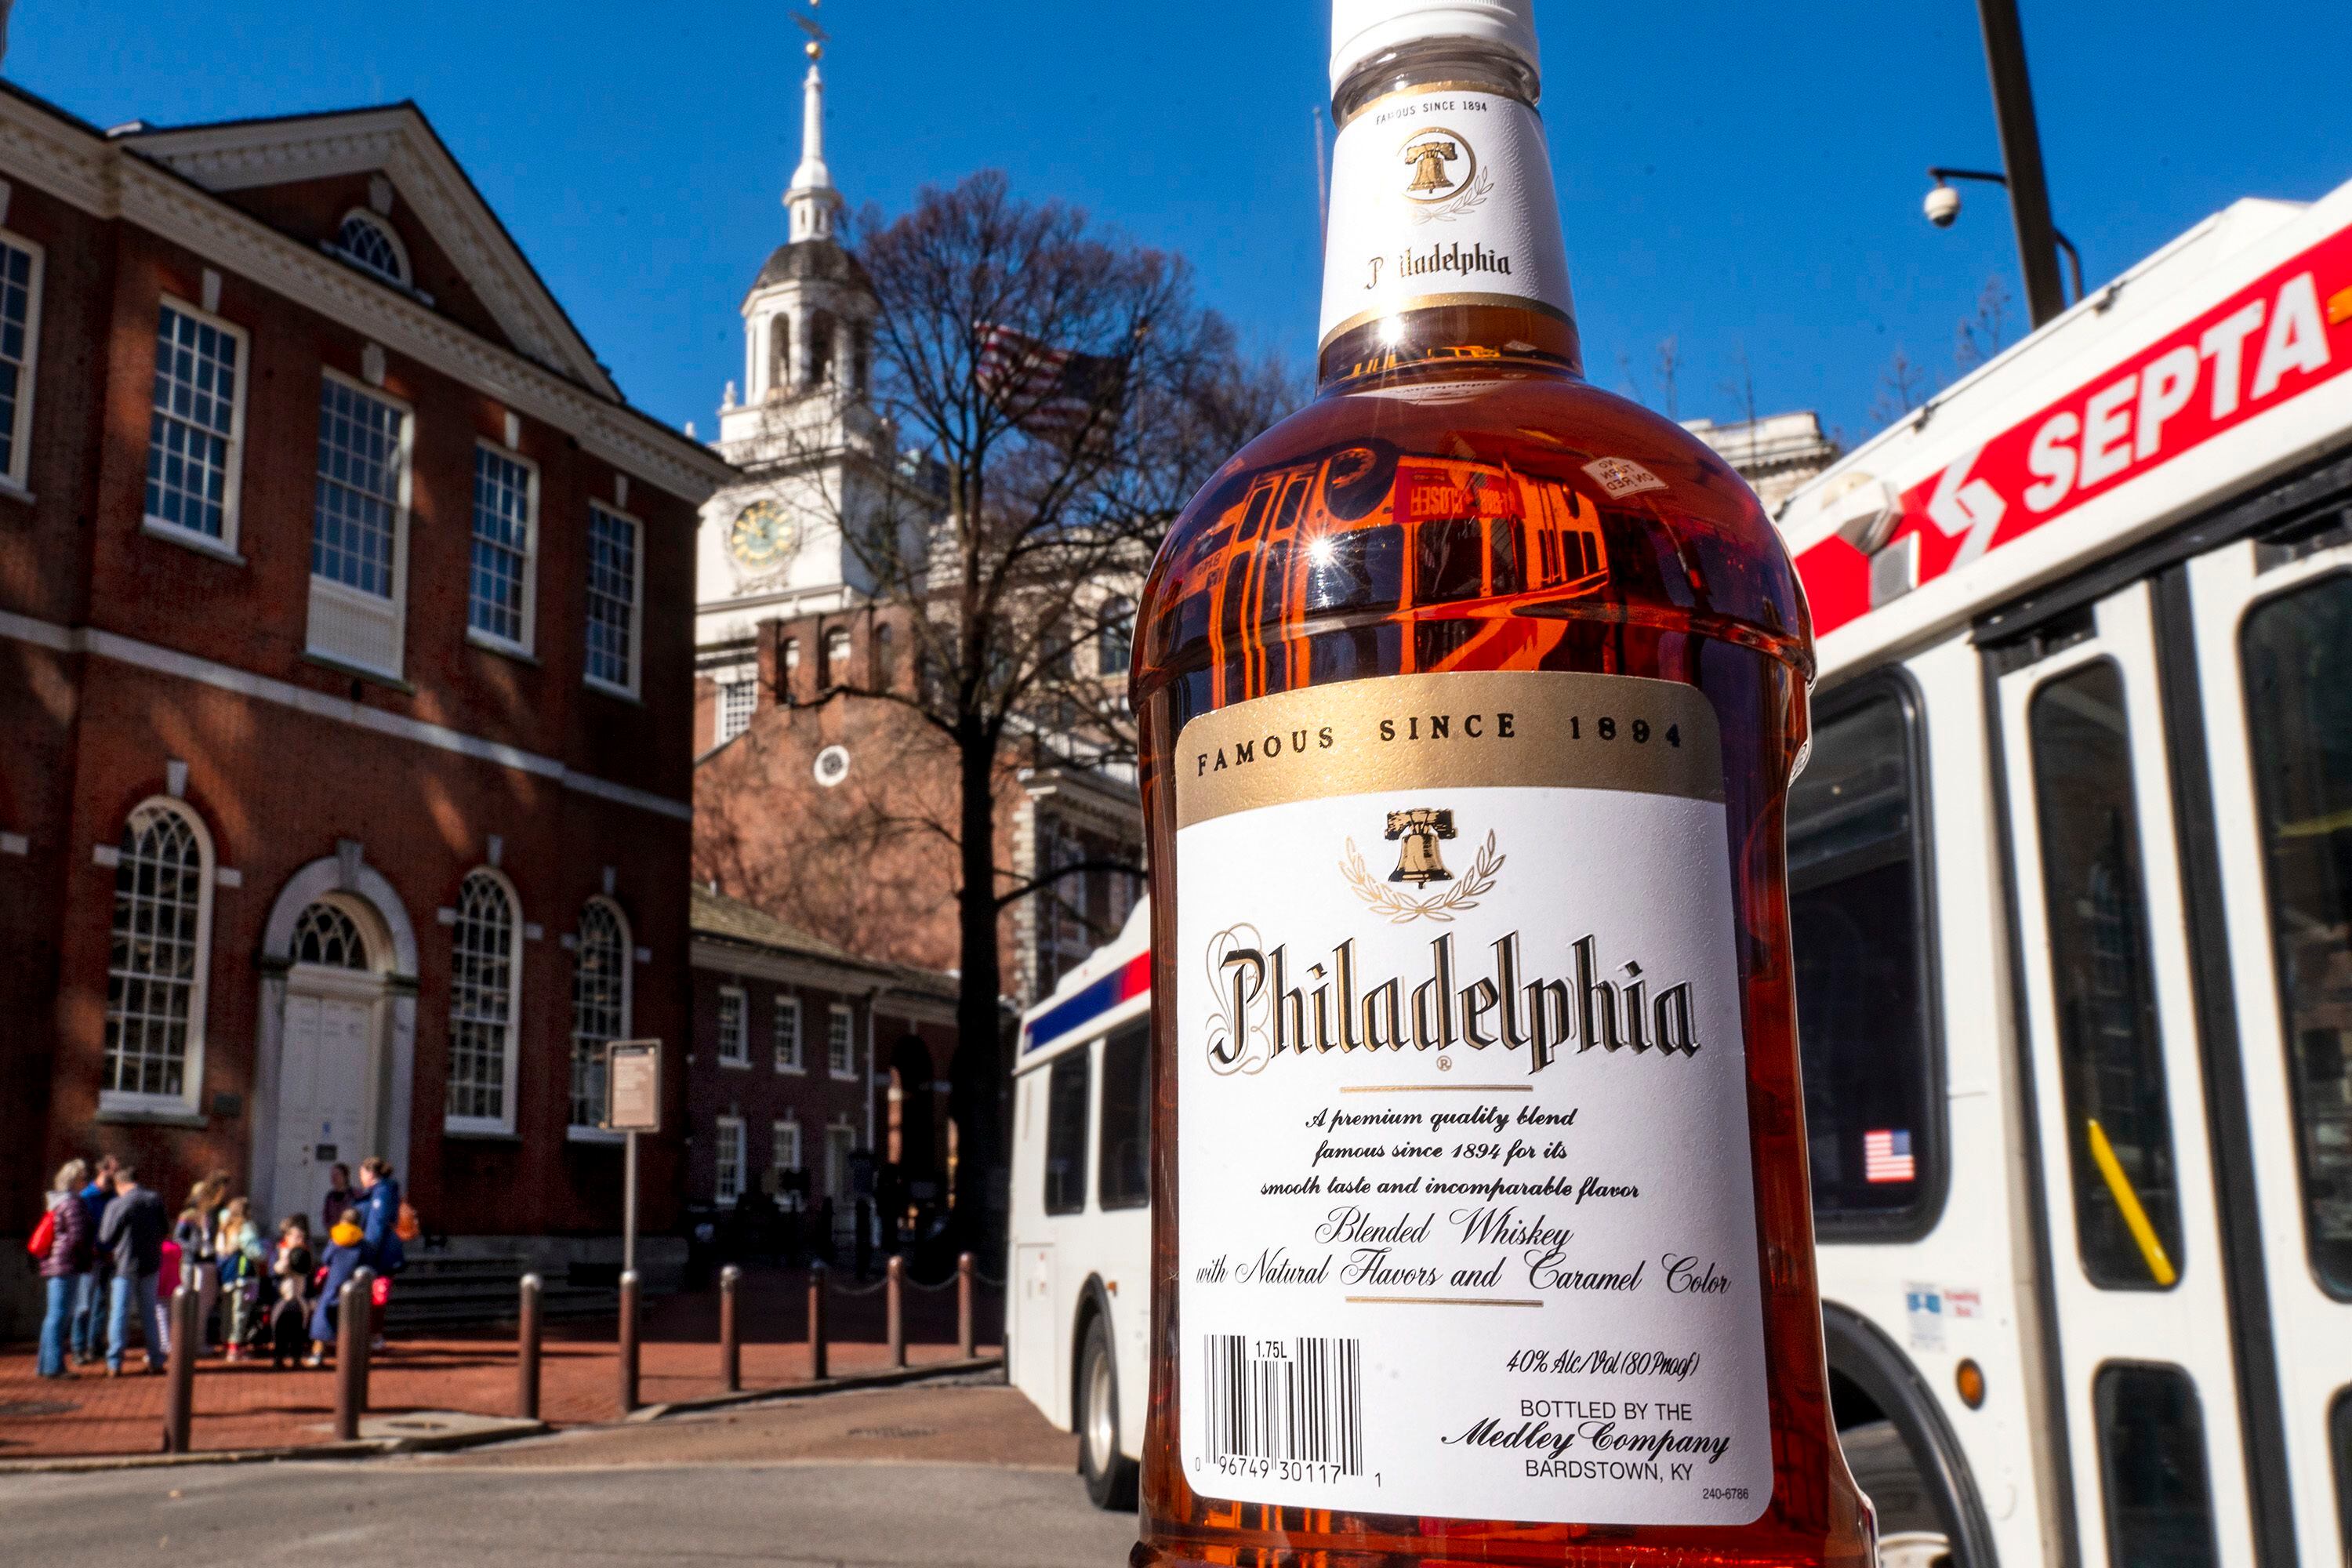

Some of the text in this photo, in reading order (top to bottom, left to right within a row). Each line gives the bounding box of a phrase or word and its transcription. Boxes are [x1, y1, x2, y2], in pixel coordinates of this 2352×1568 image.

[1423, 100, 1455, 113] SINCE
[1463, 100, 1488, 112] 1894
[1363, 241, 1512, 290] Piladelphia
[2022, 270, 2332, 515] SEPTA
[1197, 726, 1334, 777] FAMOUS
[1379, 713, 1516, 742] SINCE
[1206, 923, 1702, 1076] Philadelphia
[1305, 1105, 1579, 1133] A premium quality blend
[1312, 1139, 1568, 1167] famous since 1894 for its
[1260, 1175, 1639, 1205] smooth taste and incomparable flavor
[1314, 1205, 1575, 1258] Blended Whiskey
[1196, 1247, 1733, 1294] with Natural Flavors and Caramel Color
[1255, 1340, 1287, 1359] 1.75L
[1506, 1349, 1549, 1373] 40%
[1520, 1399, 1693, 1421] BOTTLED BY THE
[1441, 1417, 1730, 1465] Medley Company
[1195, 1456, 1381, 1488] 0 96749 30117 1
[1526, 1459, 1693, 1483] BARDSTOWN, KY
[1703, 1488, 1749, 1501] 240-6786
